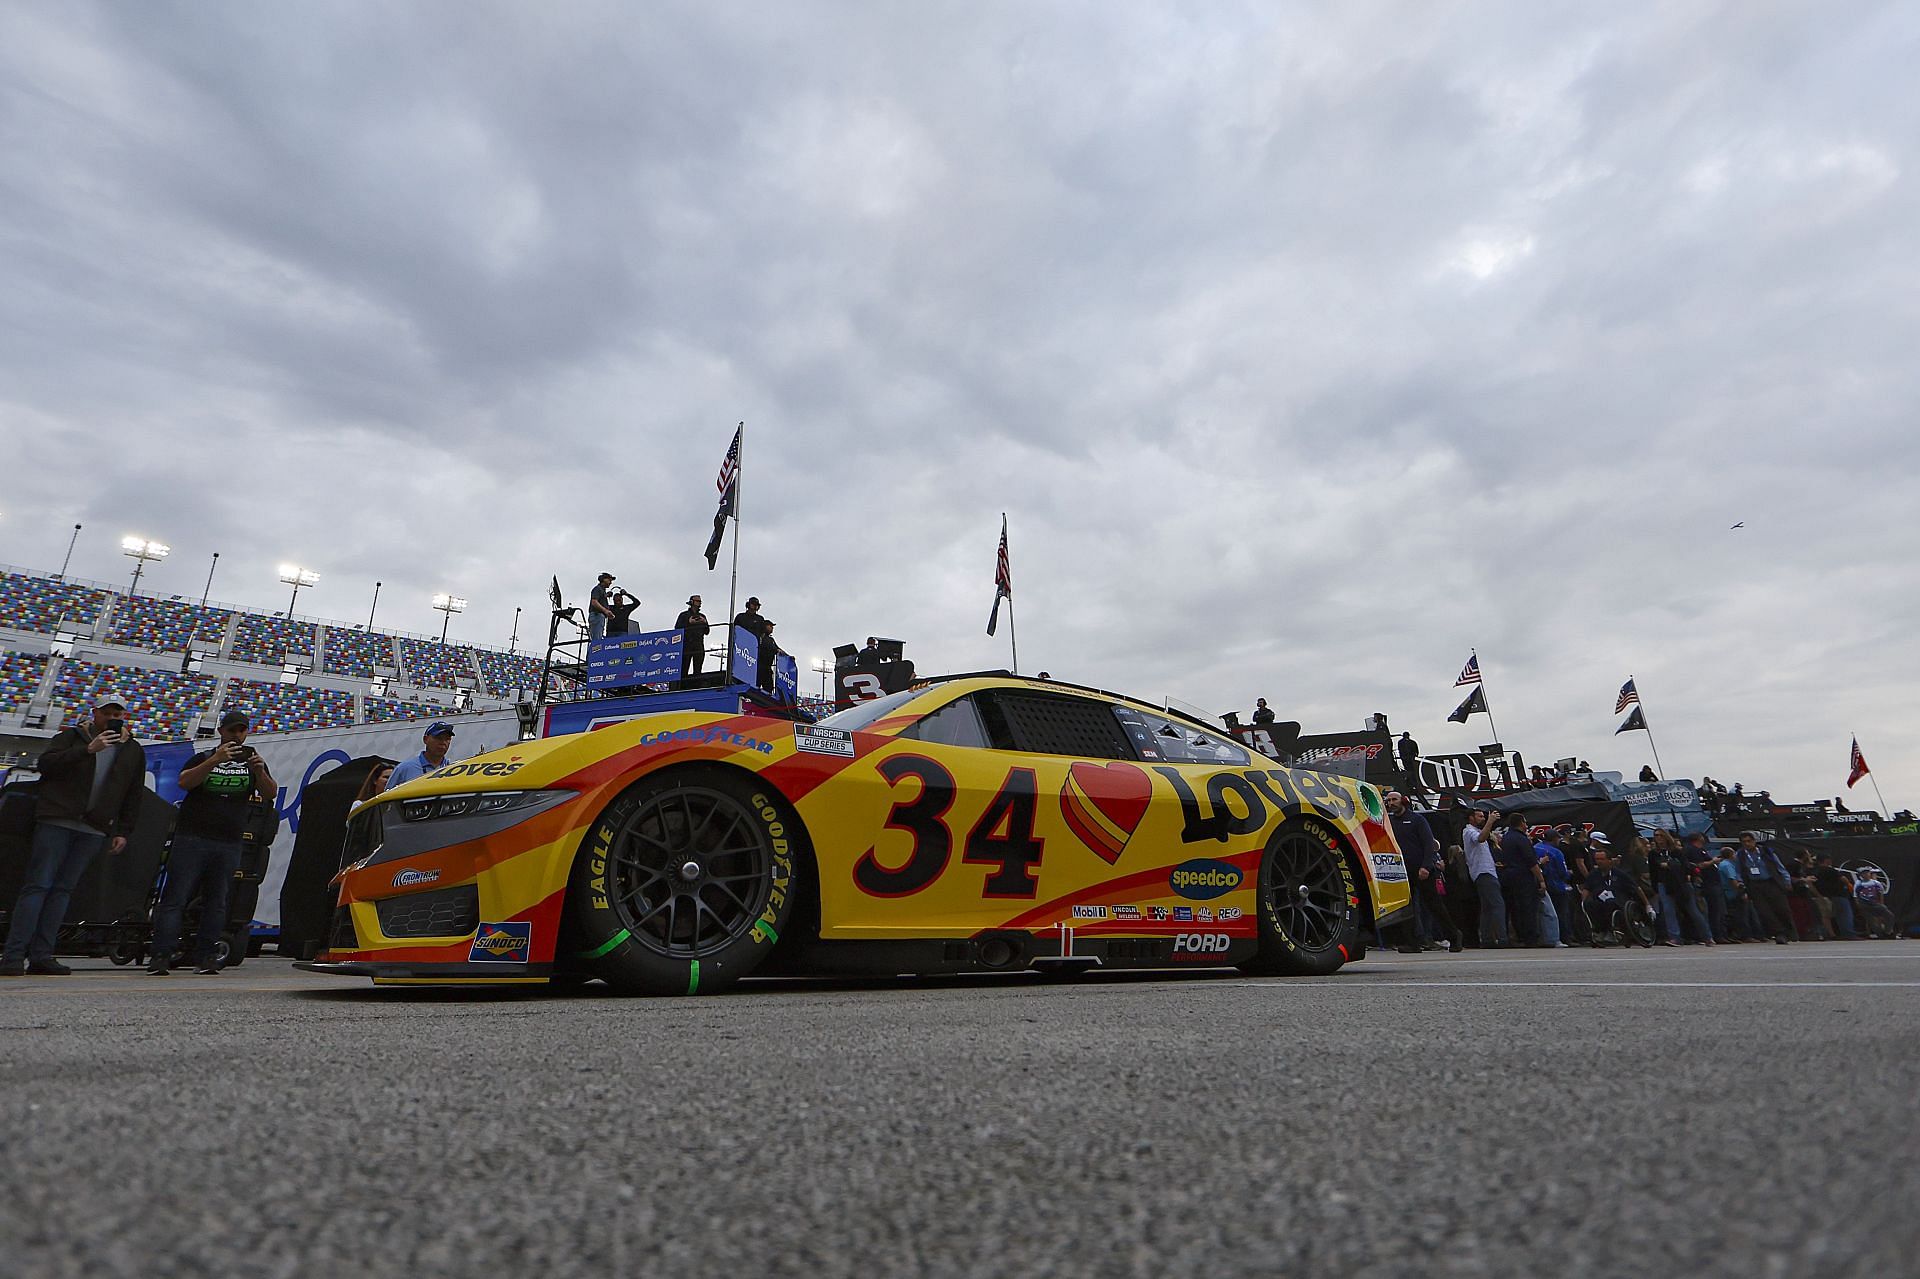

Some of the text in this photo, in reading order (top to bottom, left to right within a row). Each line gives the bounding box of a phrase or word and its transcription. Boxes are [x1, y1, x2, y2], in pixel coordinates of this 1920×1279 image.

[842, 673, 887, 706] 3
[812, 727, 844, 740] NASCAR
[639, 726, 774, 756] GOODYEAR
[804, 738, 847, 752] CUP SERIES
[211, 766, 250, 775] awasaki
[1663, 791, 1695, 801] BUSCH
[1828, 814, 1873, 823] FASTENAL
[852, 752, 1046, 900] 34
[590, 824, 614, 910] EAGLE
[749, 792, 792, 944] GOODYEAR
[1172, 868, 1239, 888] speedco
[1074, 906, 1107, 918] Mobil 1
[1112, 905, 1137, 914] LINCOLN
[477, 937, 528, 948] SUNOCO
[1173, 933, 1231, 952] FORD
